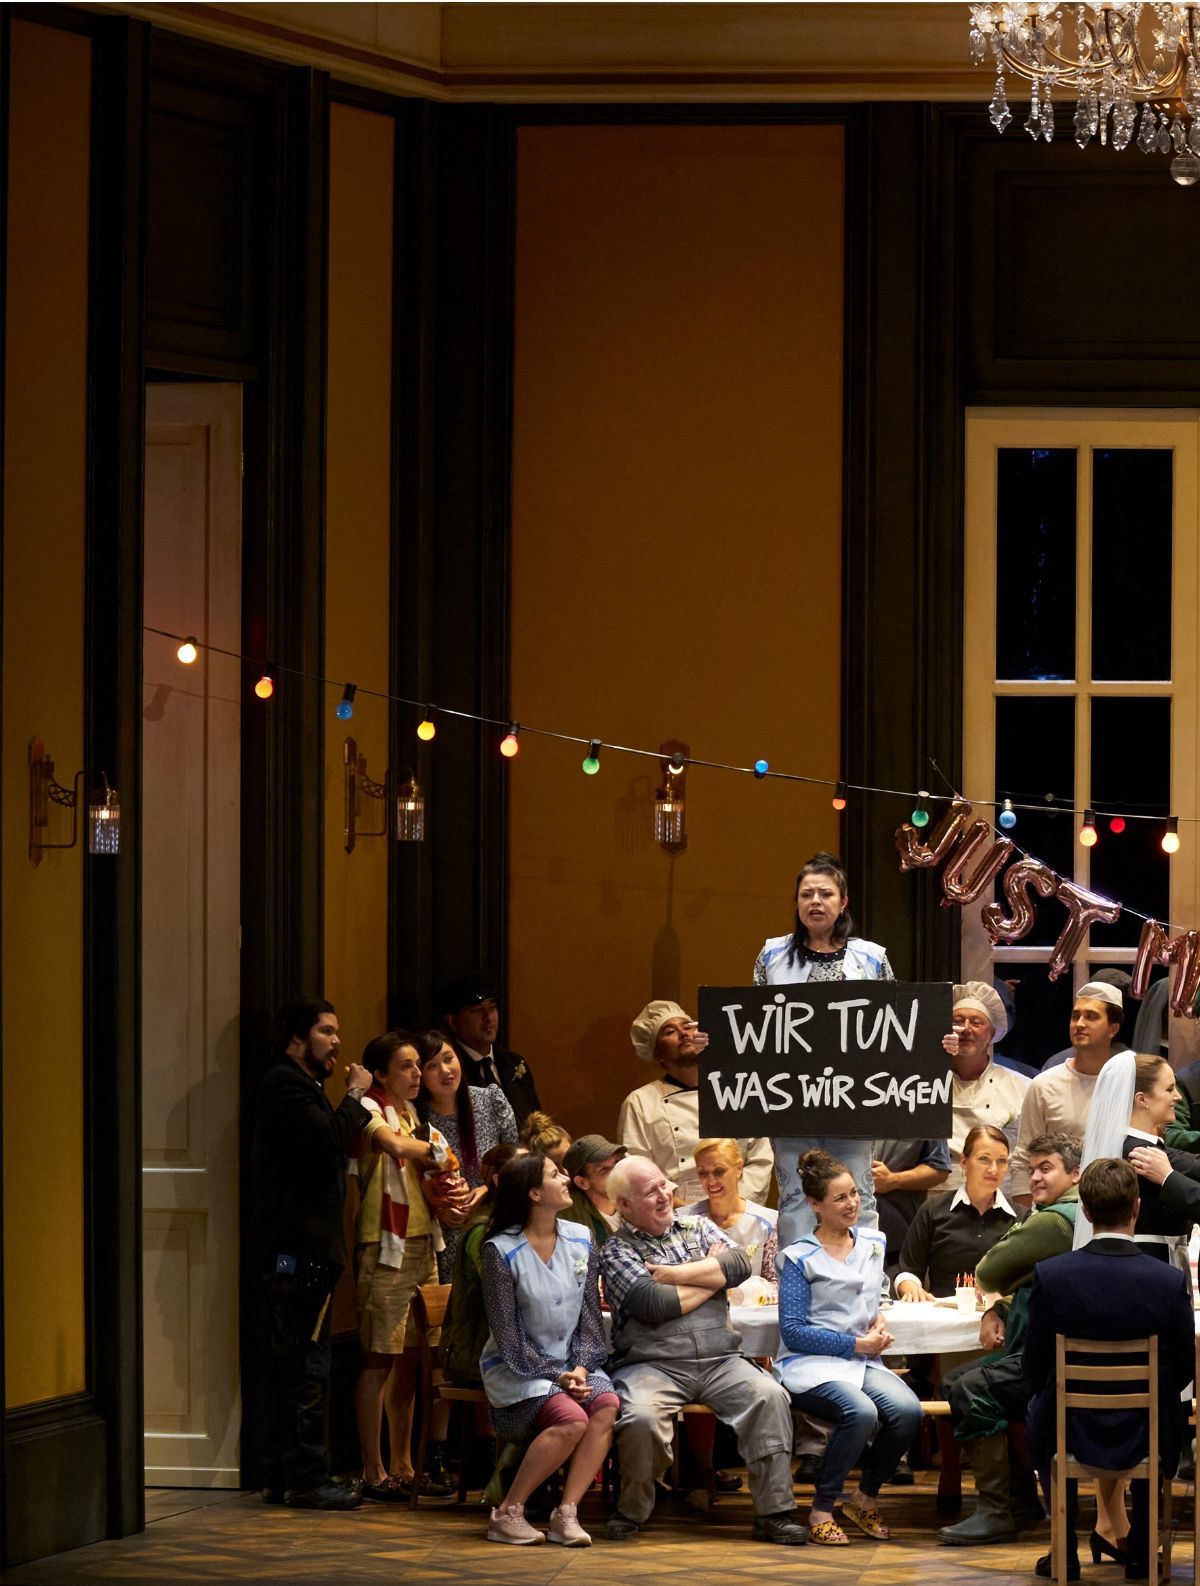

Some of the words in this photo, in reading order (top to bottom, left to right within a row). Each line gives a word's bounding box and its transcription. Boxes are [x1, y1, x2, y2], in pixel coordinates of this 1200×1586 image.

[894, 793, 1121, 982] JUST
[827, 999, 918, 1053] TUN
[707, 1071, 793, 1114] WAS
[861, 1069, 953, 1115] SAGEN
